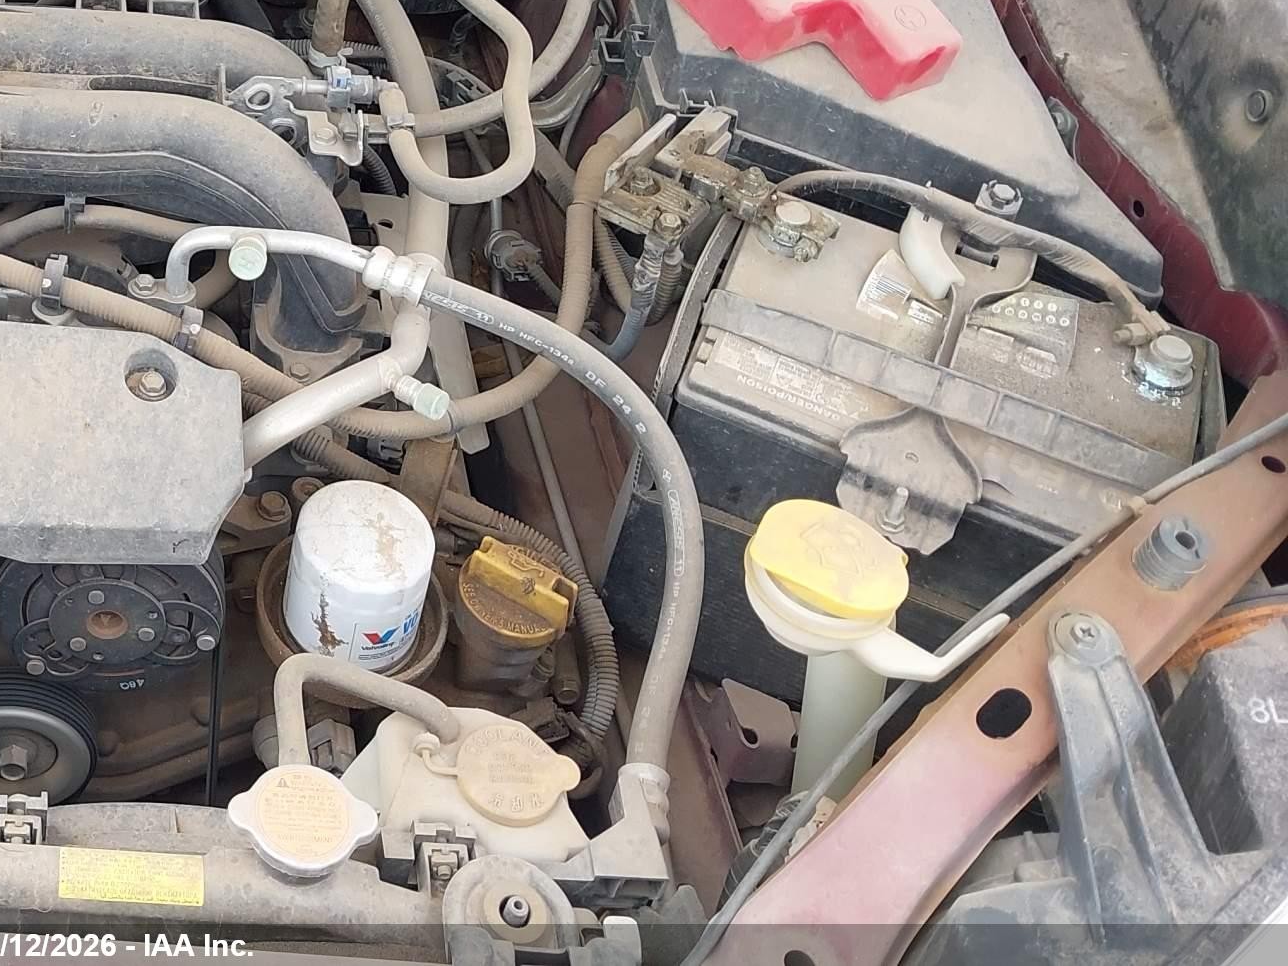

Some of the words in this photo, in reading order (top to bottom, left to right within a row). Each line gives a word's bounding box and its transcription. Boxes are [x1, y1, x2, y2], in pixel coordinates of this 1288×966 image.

[498, 321, 515, 335] HP
[518, 330, 576, 367] HFC-134a
[584, 370, 607, 389] DF
[611, 393, 633, 416] 24
[736, 373, 842, 422] DANGER/POISON
